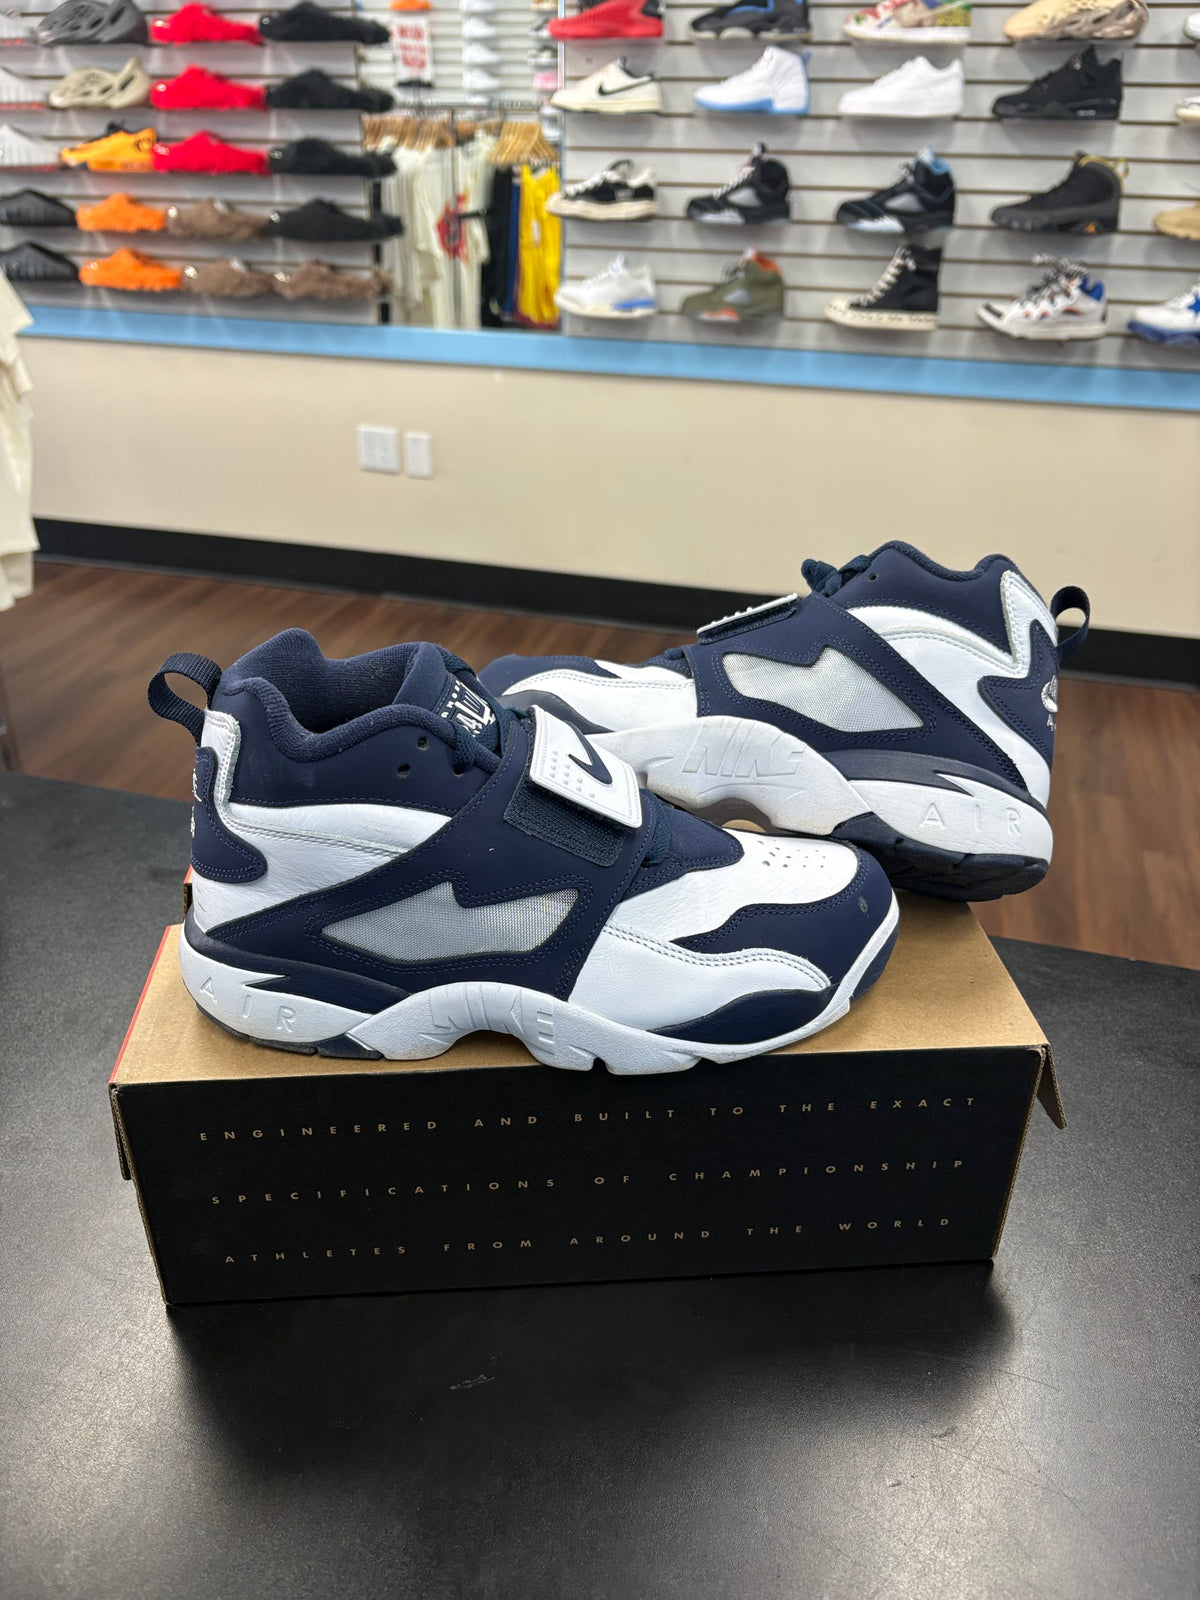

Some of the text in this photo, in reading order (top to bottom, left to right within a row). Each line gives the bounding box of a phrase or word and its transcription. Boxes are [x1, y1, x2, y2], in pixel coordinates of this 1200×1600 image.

[920, 802, 1023, 838] AIR
[200, 976, 294, 1033] AIR
[200, 1098, 974, 1141] ENGINEERED AND BUILT TO THE EXACT
[212, 1160, 962, 1205] SPECIFICATIONS OF CHAMPIONSHIP
[225, 1218, 950, 1264] ATHLETES FROM AROUND THE WORLD
